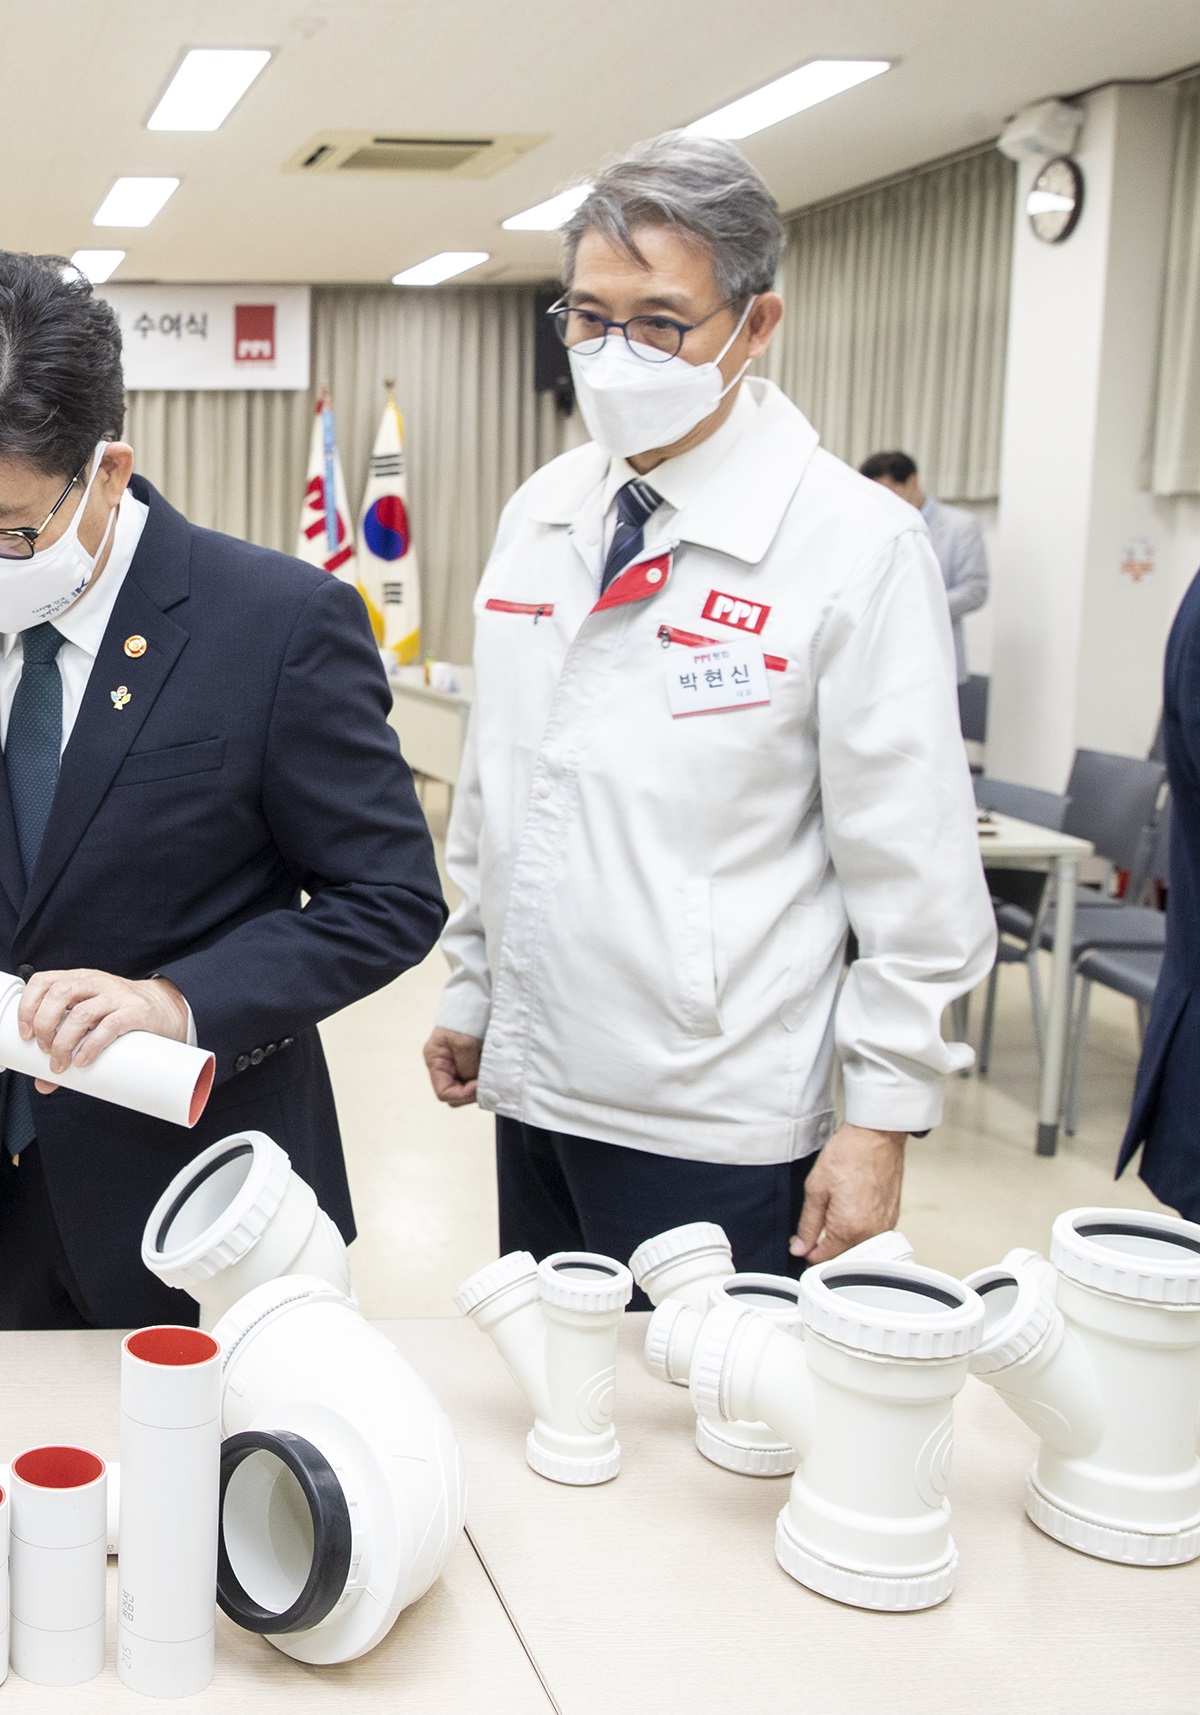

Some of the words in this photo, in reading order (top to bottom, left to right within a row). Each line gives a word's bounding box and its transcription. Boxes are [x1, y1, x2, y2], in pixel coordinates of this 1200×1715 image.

[135, 312, 207, 340] 수여식
[710, 594, 762, 631] PPI
[680, 664, 750, 692] 박현신
